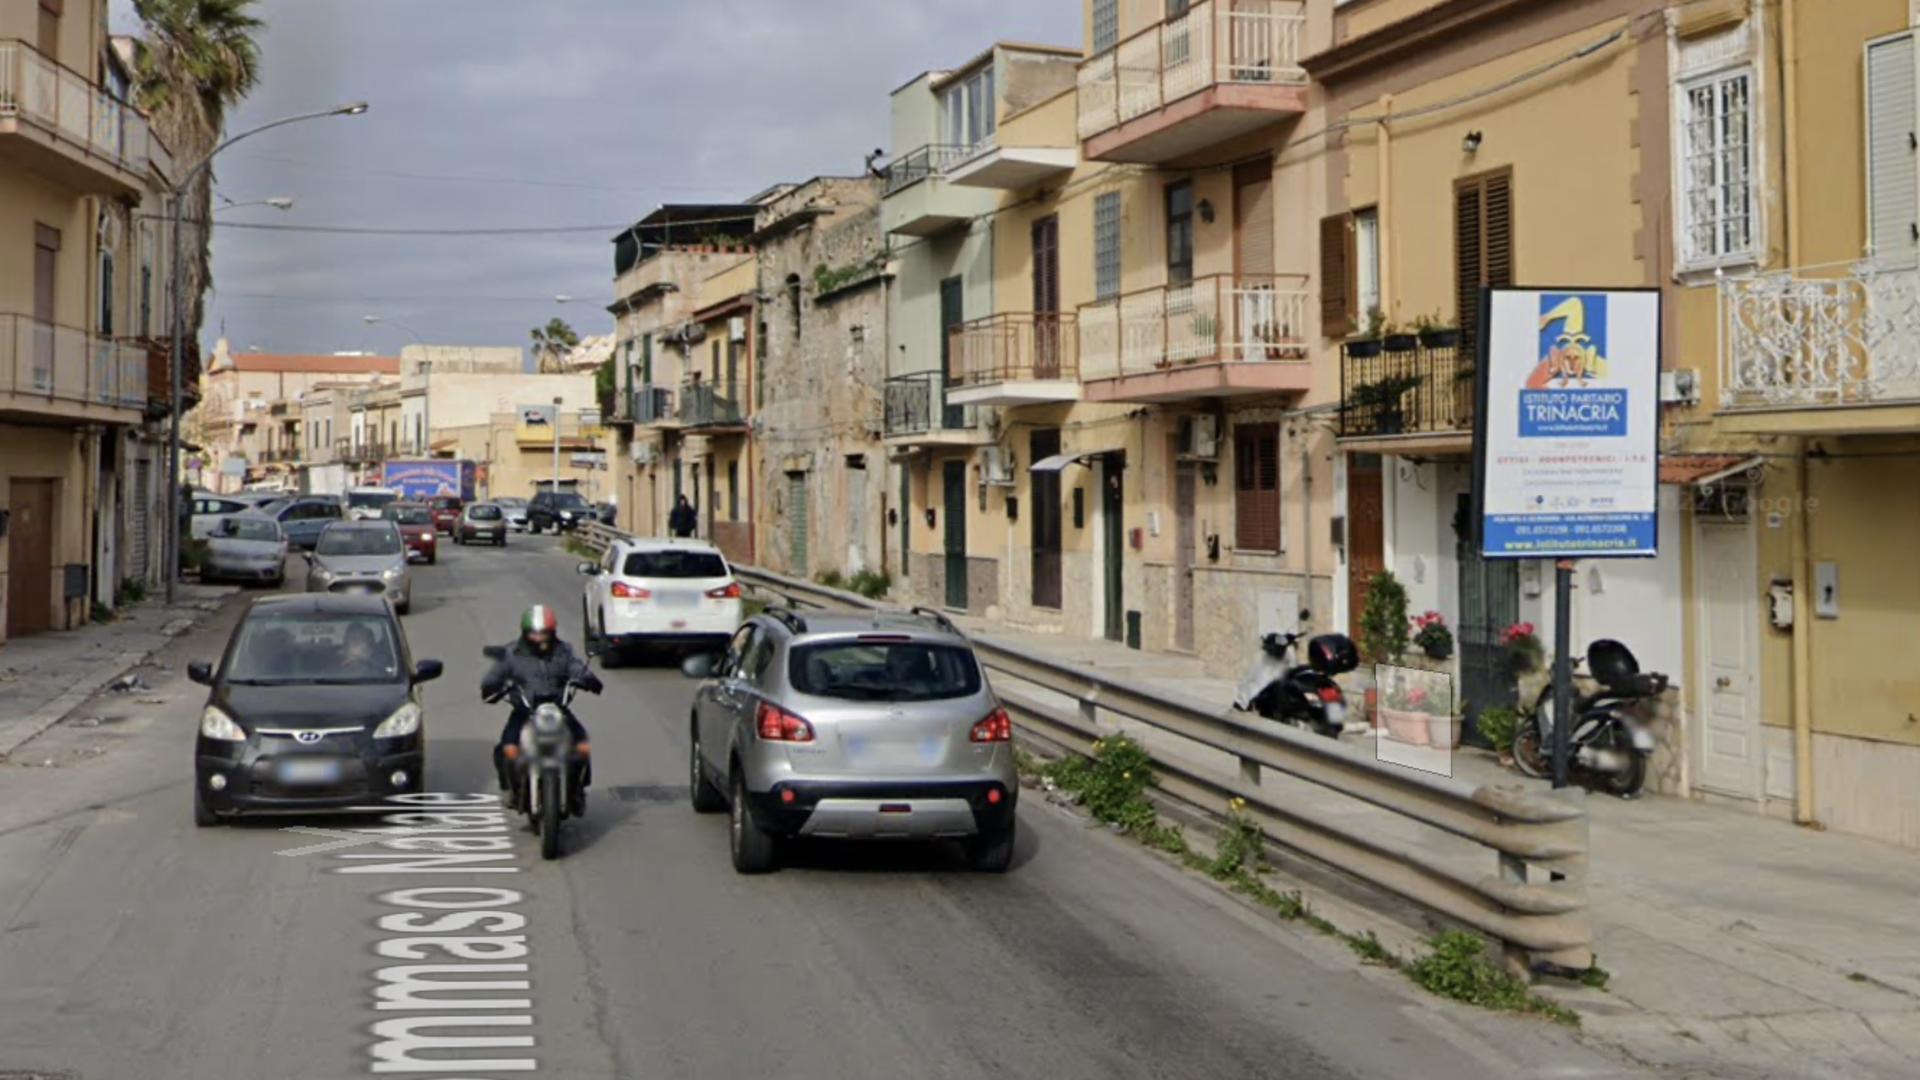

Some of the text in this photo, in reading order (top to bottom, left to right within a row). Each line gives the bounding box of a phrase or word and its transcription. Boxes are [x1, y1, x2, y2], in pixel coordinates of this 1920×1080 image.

[1523, 393, 1623, 404] ISTITUTO PARITARIO
[1527, 404, 1619, 422] TRINACRIA
